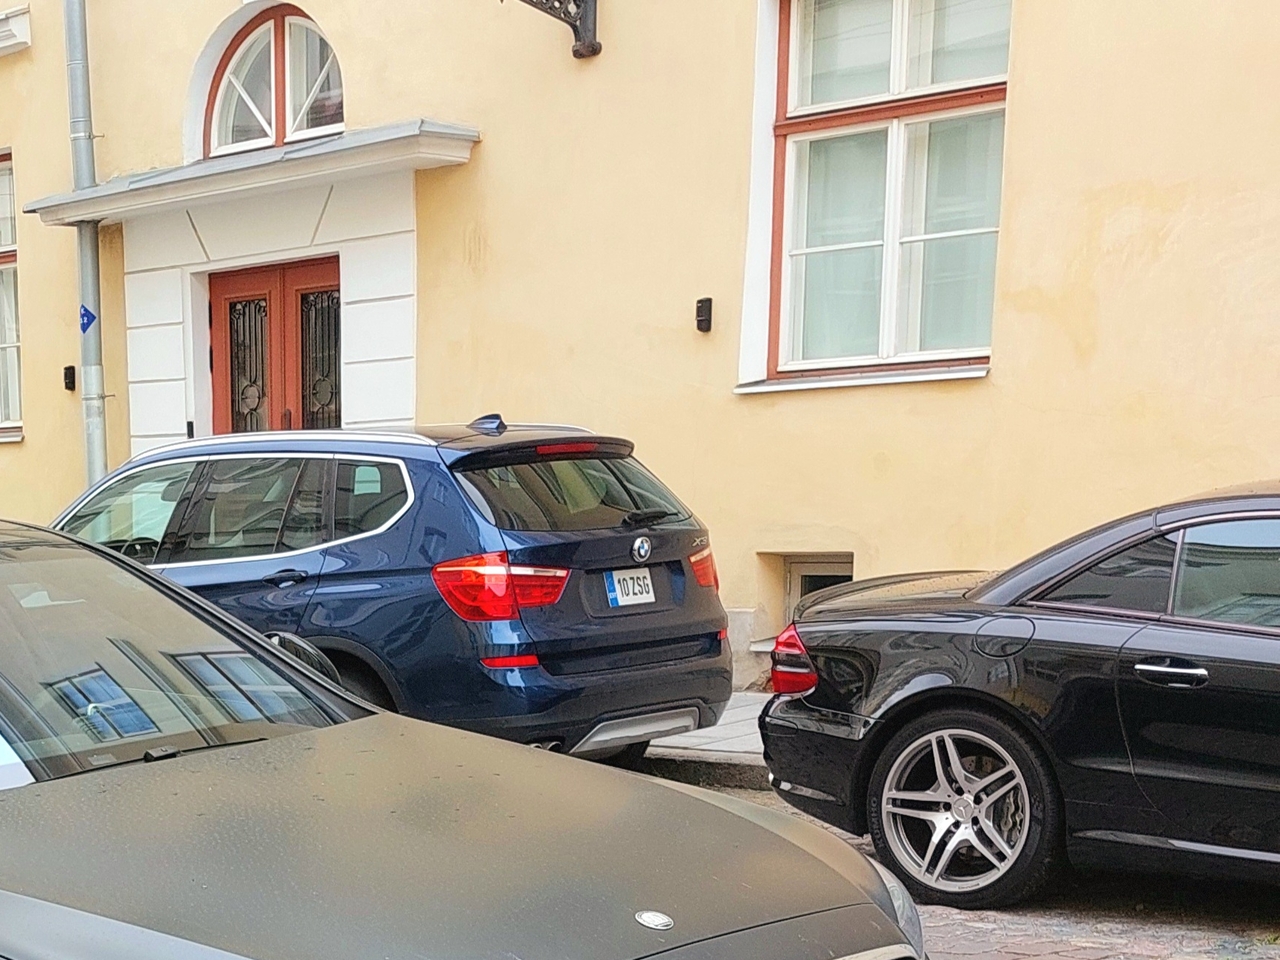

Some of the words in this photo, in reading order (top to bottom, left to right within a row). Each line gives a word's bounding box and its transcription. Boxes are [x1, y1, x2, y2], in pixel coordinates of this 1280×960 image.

[692, 536, 708, 547] X3
[617, 577, 630, 598] 10
[629, 575, 651, 597] ZSG
